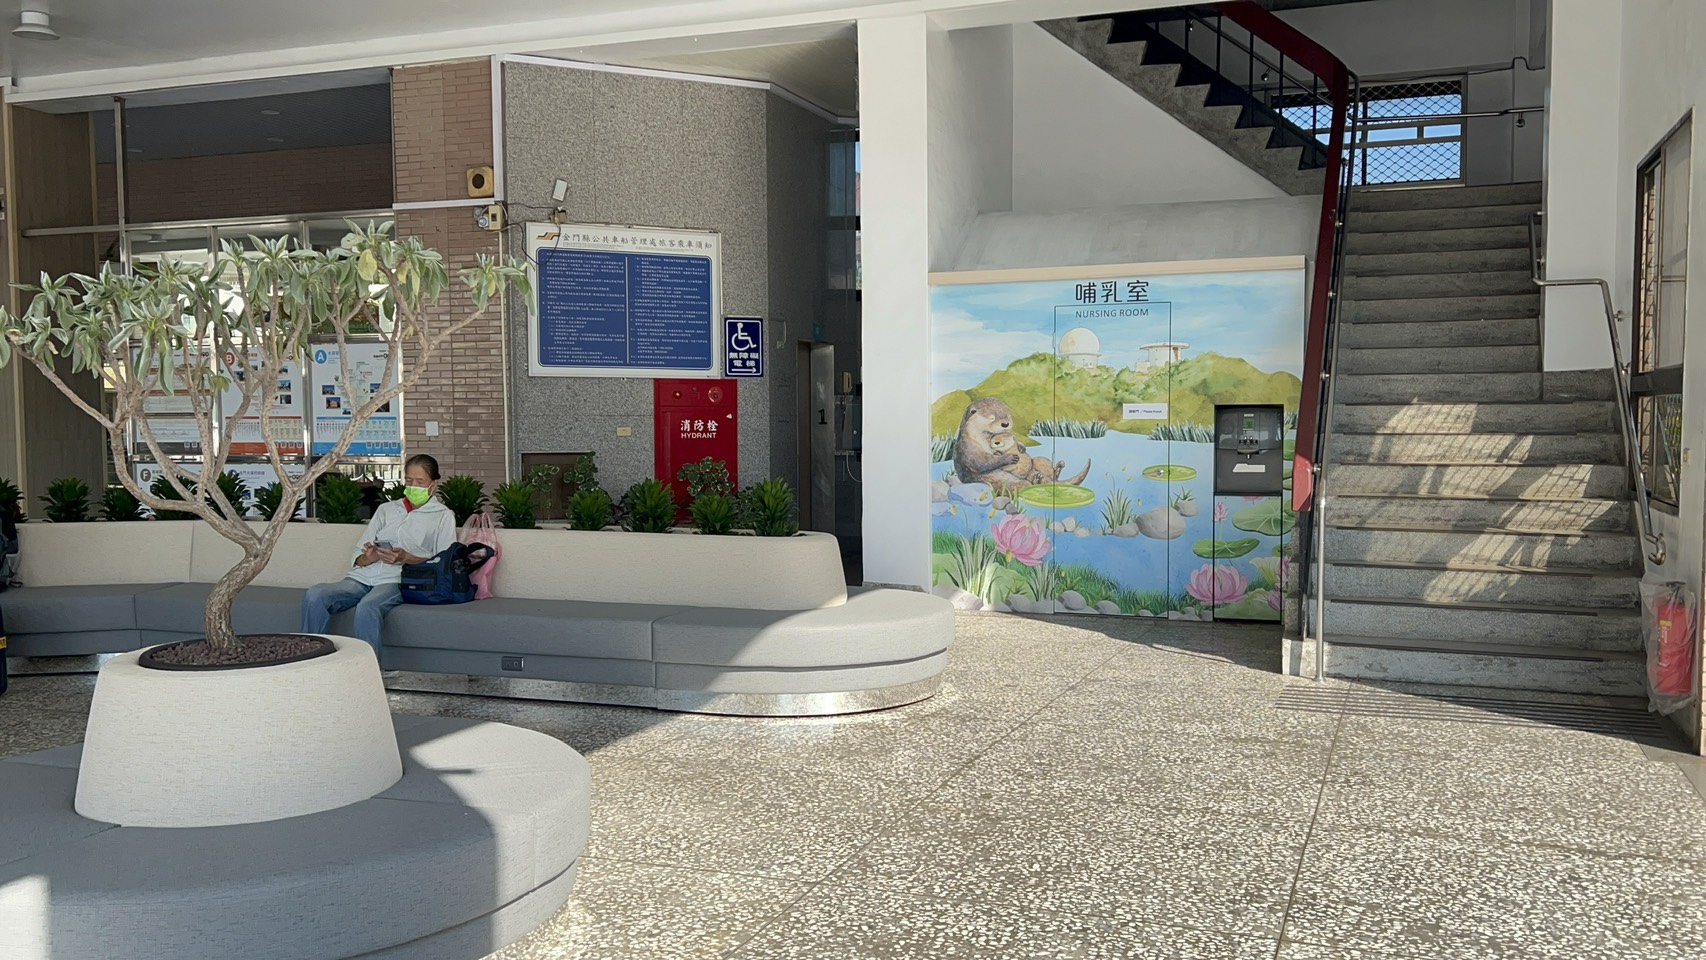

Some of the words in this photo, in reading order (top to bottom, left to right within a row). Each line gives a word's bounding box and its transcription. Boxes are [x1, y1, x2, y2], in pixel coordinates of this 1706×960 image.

[1075, 280, 1149, 303] 哺乳室
[1075, 309, 1117, 318] NURSING
[1119, 308, 1149, 317] ROOM
[818, 409, 827, 424] 1
[680, 419, 719, 432] 消防栓
